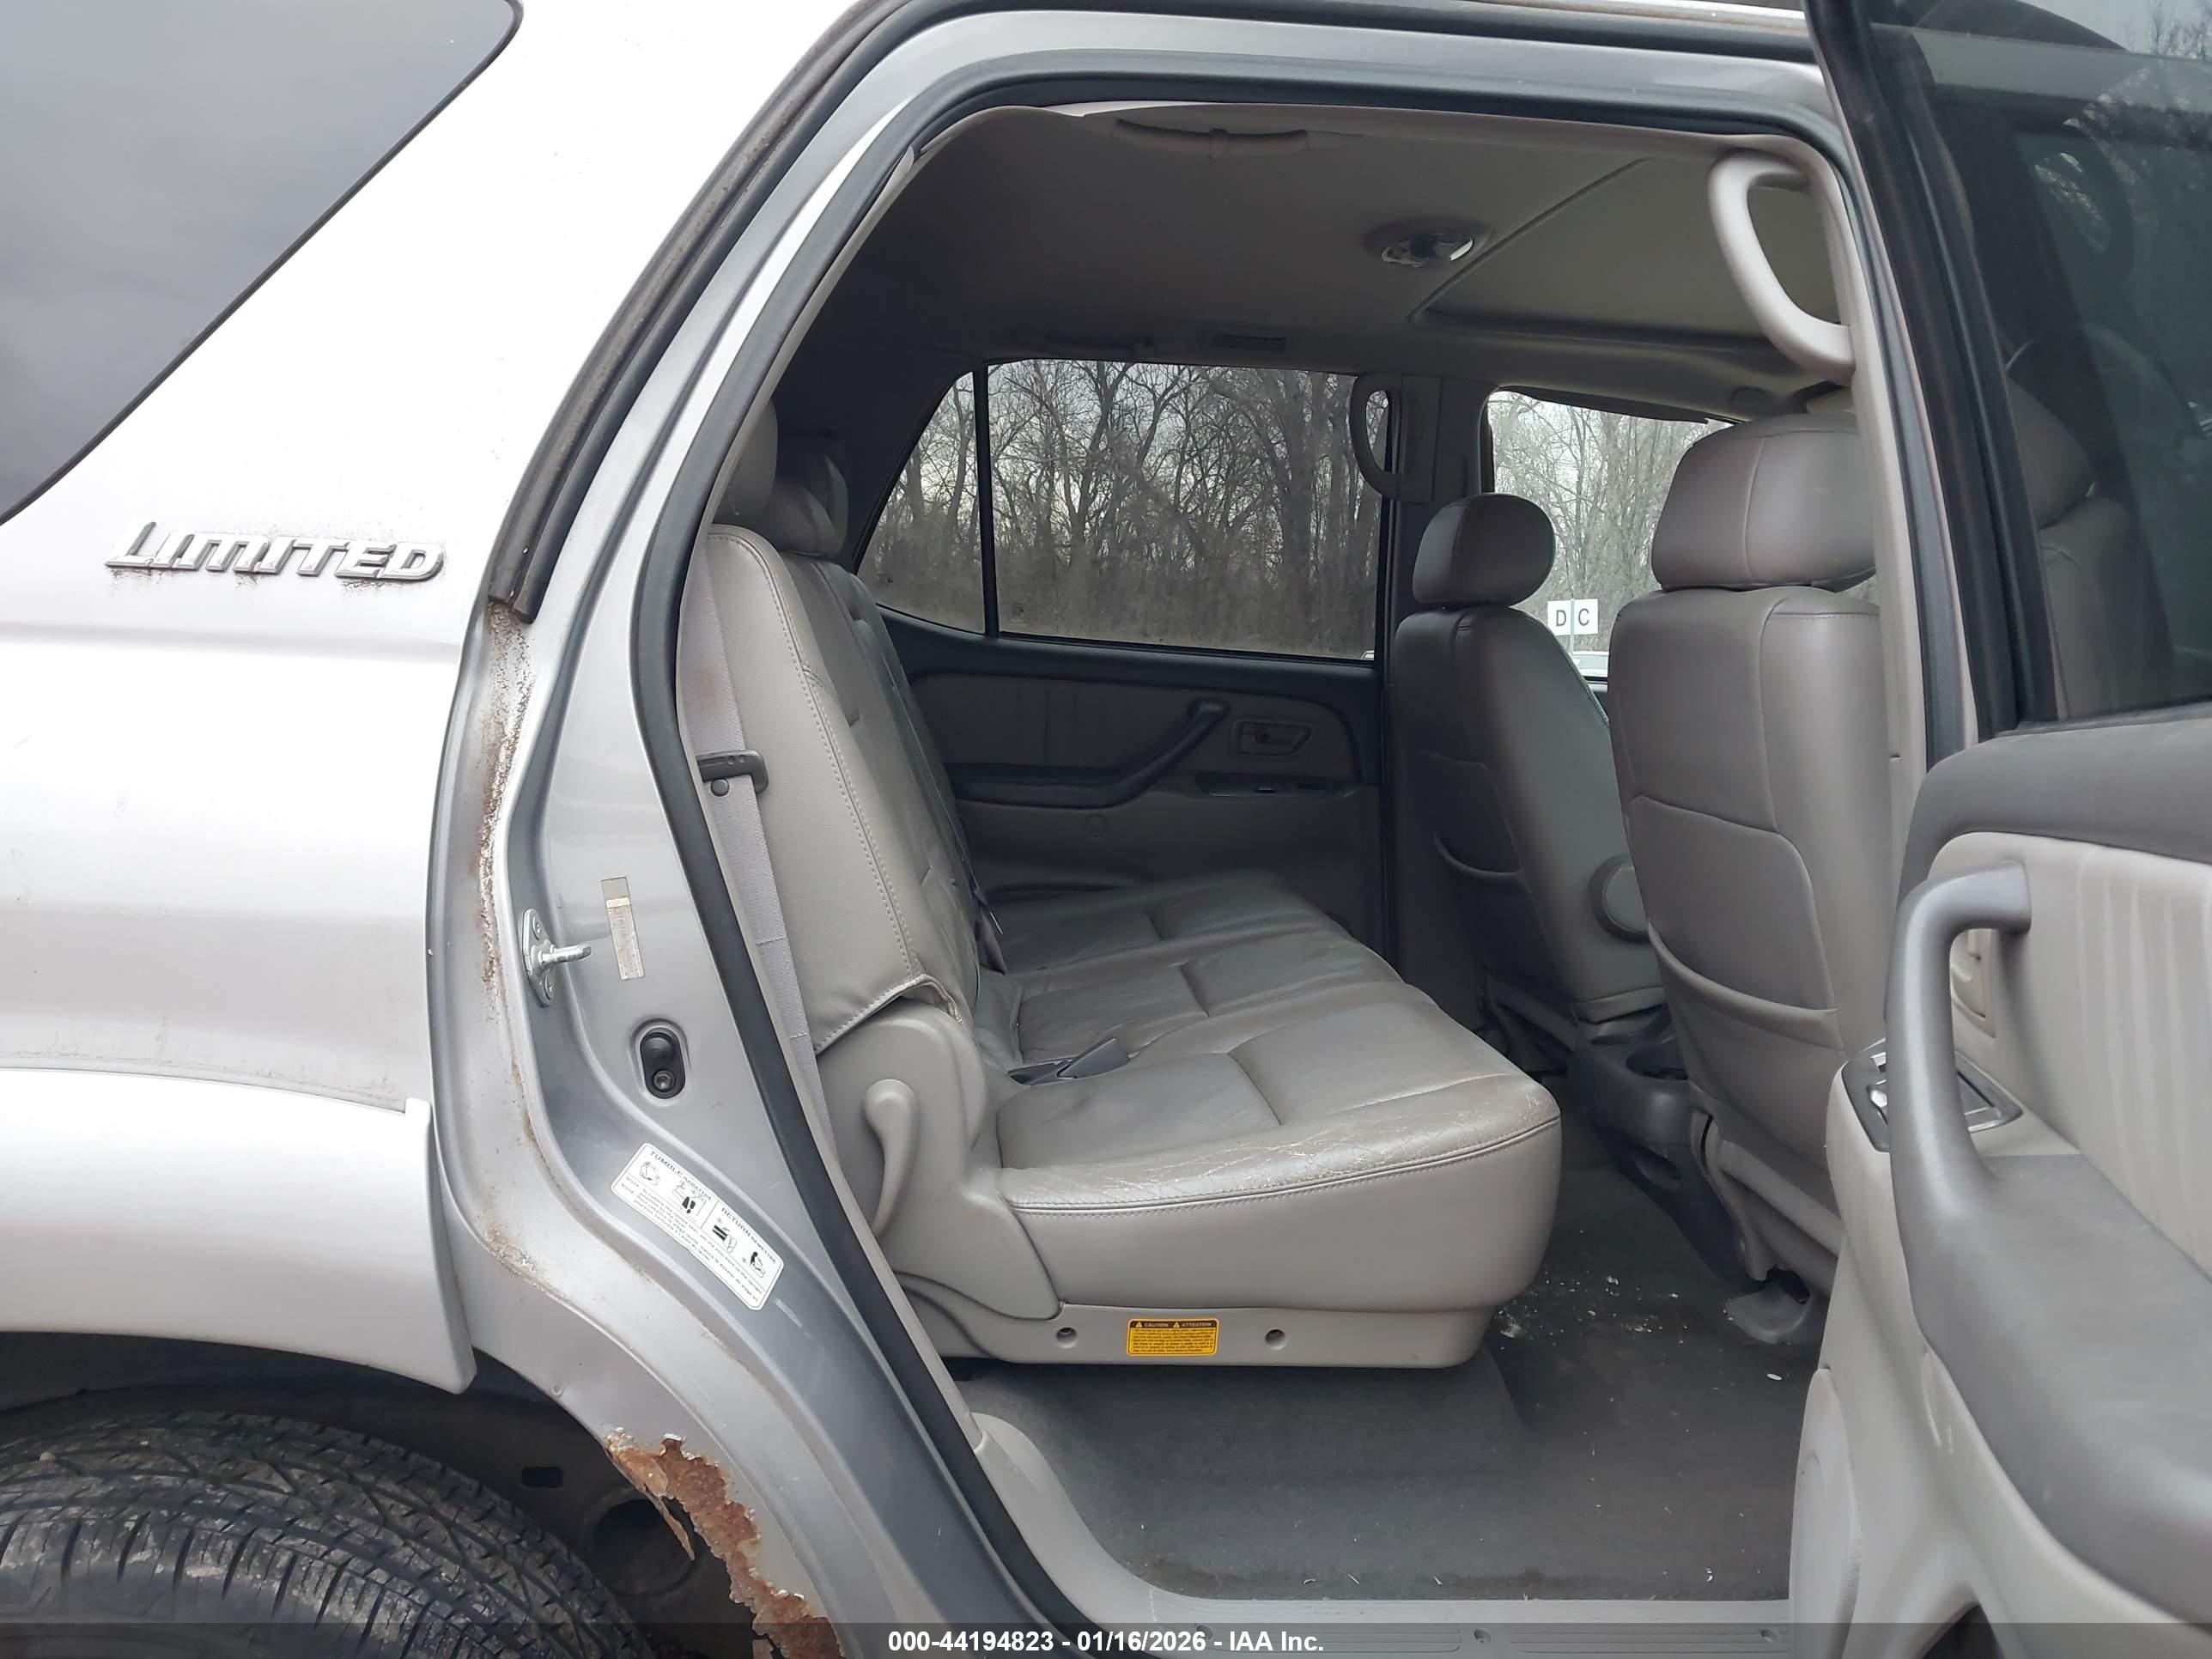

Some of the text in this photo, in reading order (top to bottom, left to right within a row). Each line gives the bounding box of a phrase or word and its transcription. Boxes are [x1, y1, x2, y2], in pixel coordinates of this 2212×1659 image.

[104, 521, 446, 581] LIMITED
[1556, 608, 1590, 627] D C
[721, 1207, 751, 1237] RETURN
